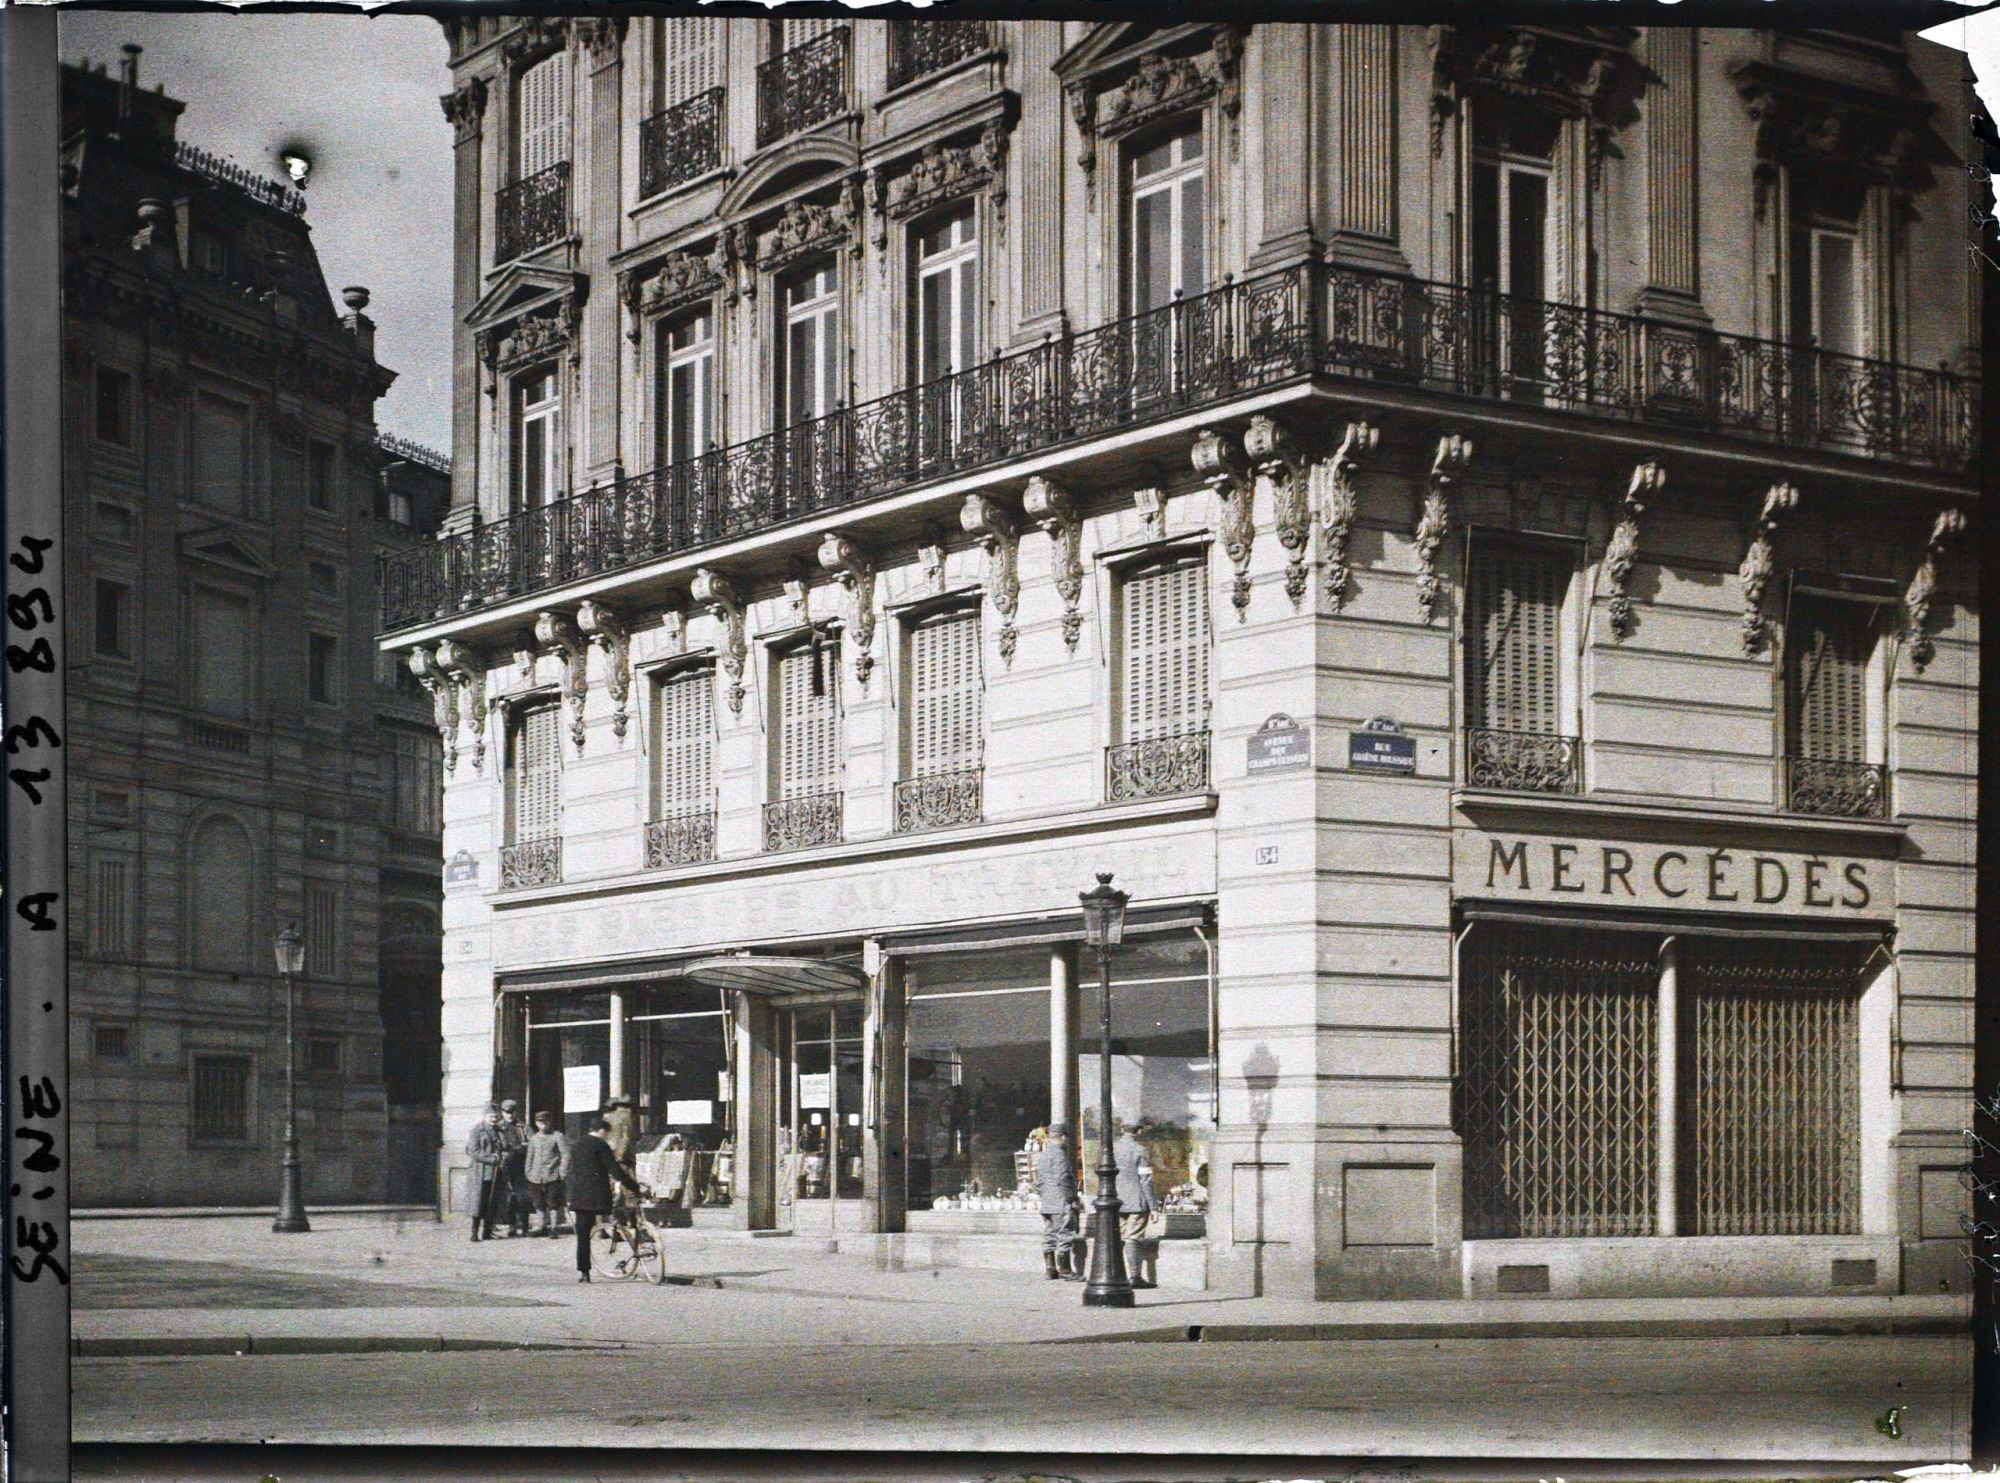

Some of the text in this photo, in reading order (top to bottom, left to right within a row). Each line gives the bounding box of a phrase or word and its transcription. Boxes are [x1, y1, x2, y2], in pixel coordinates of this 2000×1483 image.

[7, 535, 56, 674] 894
[7, 714, 62, 805] 13
[1257, 847, 1277, 864] 154
[1486, 838, 1870, 909] MERCÉDÈS
[17, 893, 58, 930] A
